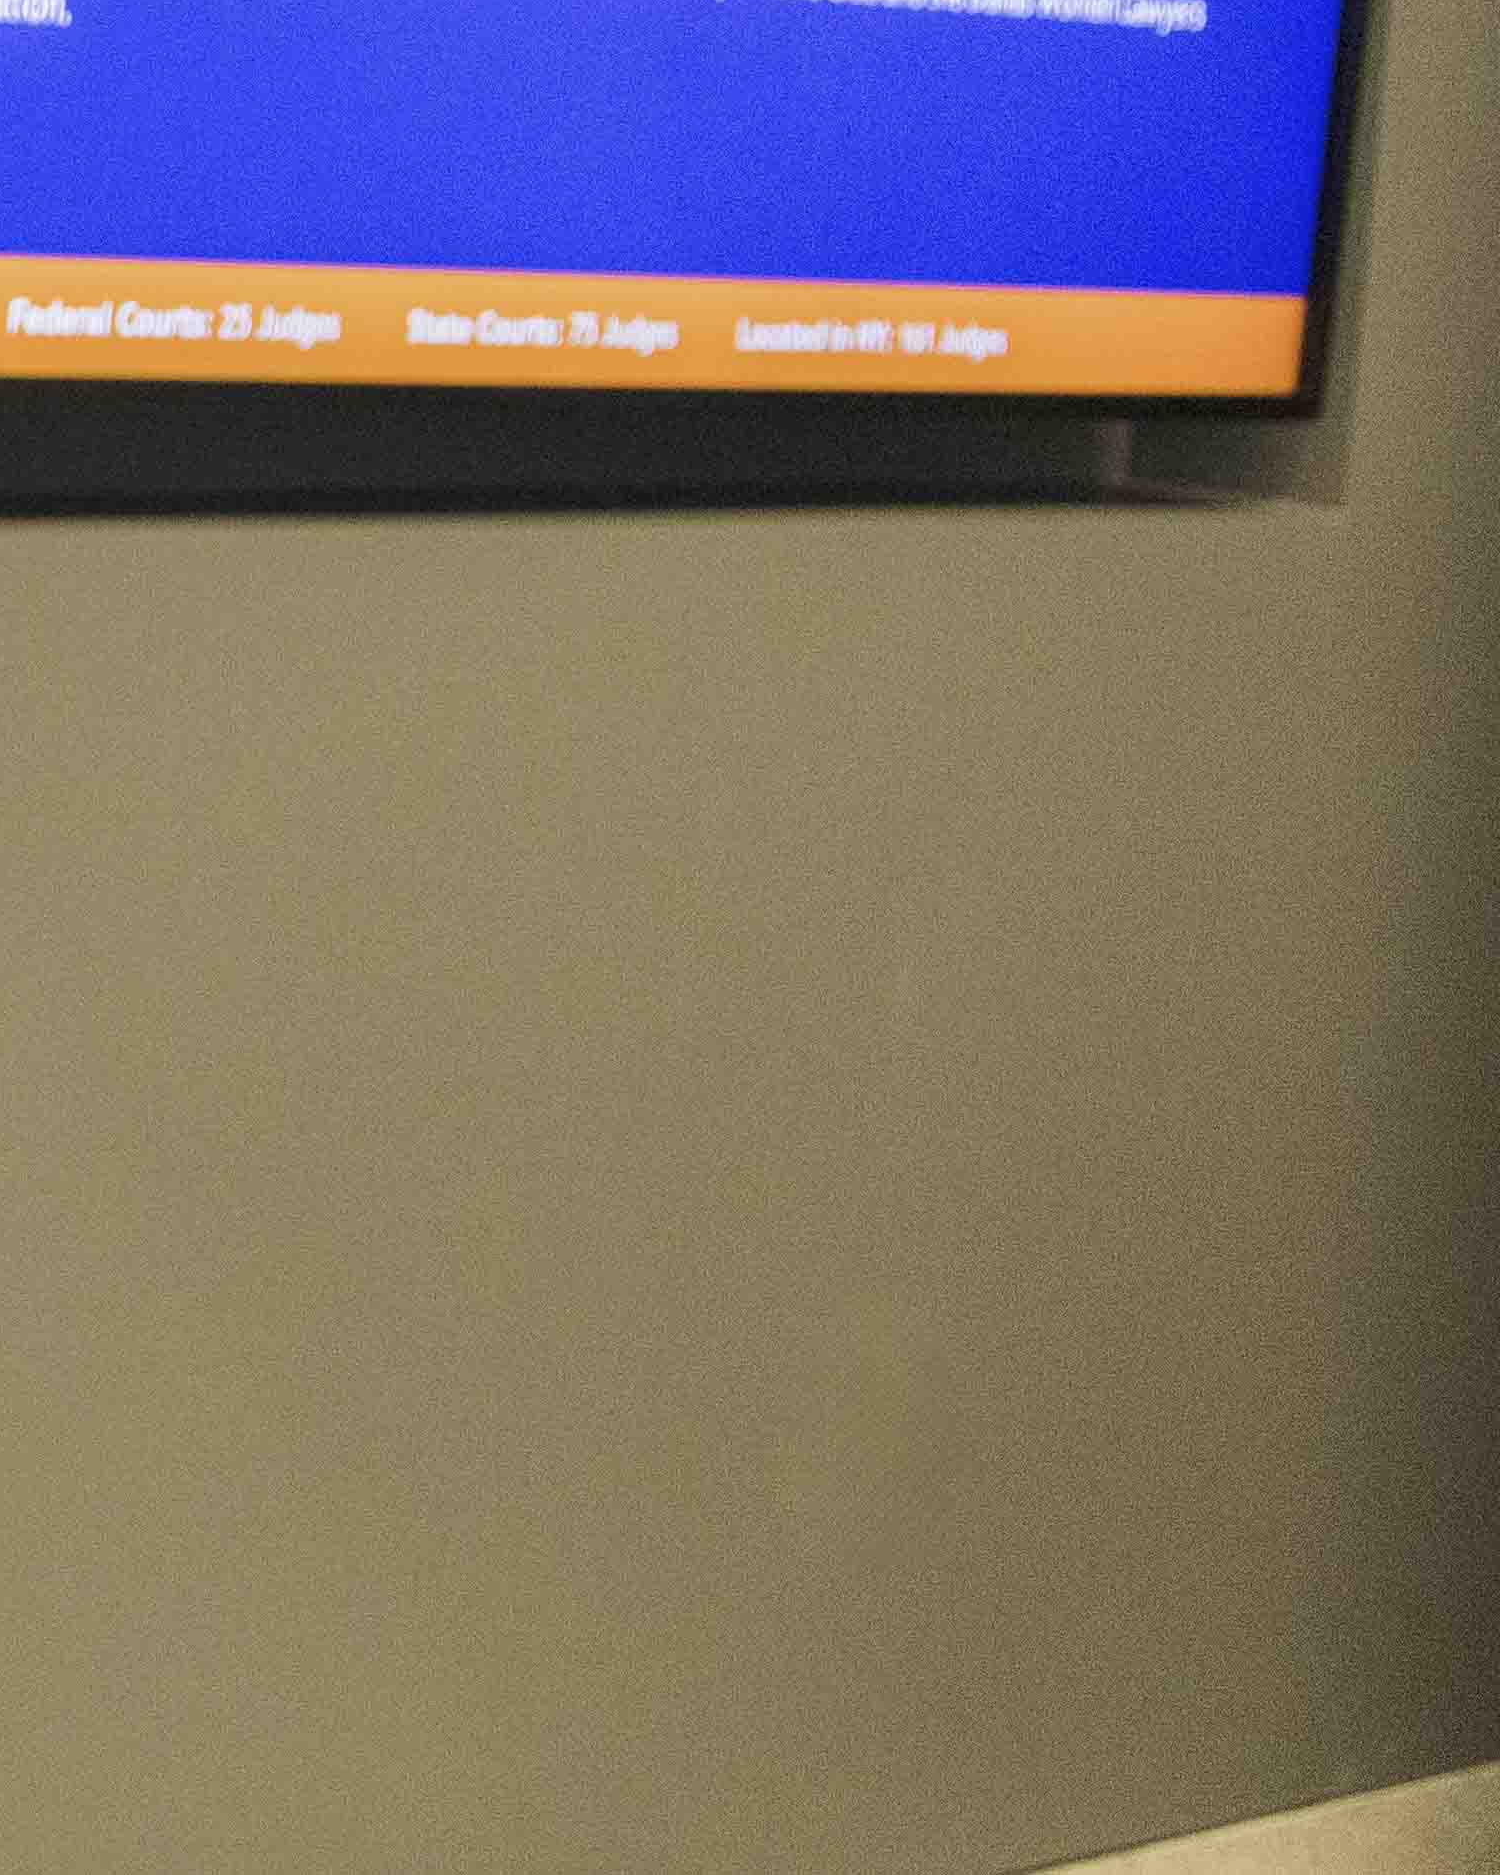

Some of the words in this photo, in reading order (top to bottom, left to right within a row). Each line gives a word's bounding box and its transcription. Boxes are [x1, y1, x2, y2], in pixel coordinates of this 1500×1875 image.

[5, 296, 114, 338] Federal
[257, 305, 342, 350] Judges
[406, 307, 474, 346] State
[603, 313, 679, 356] Judges
